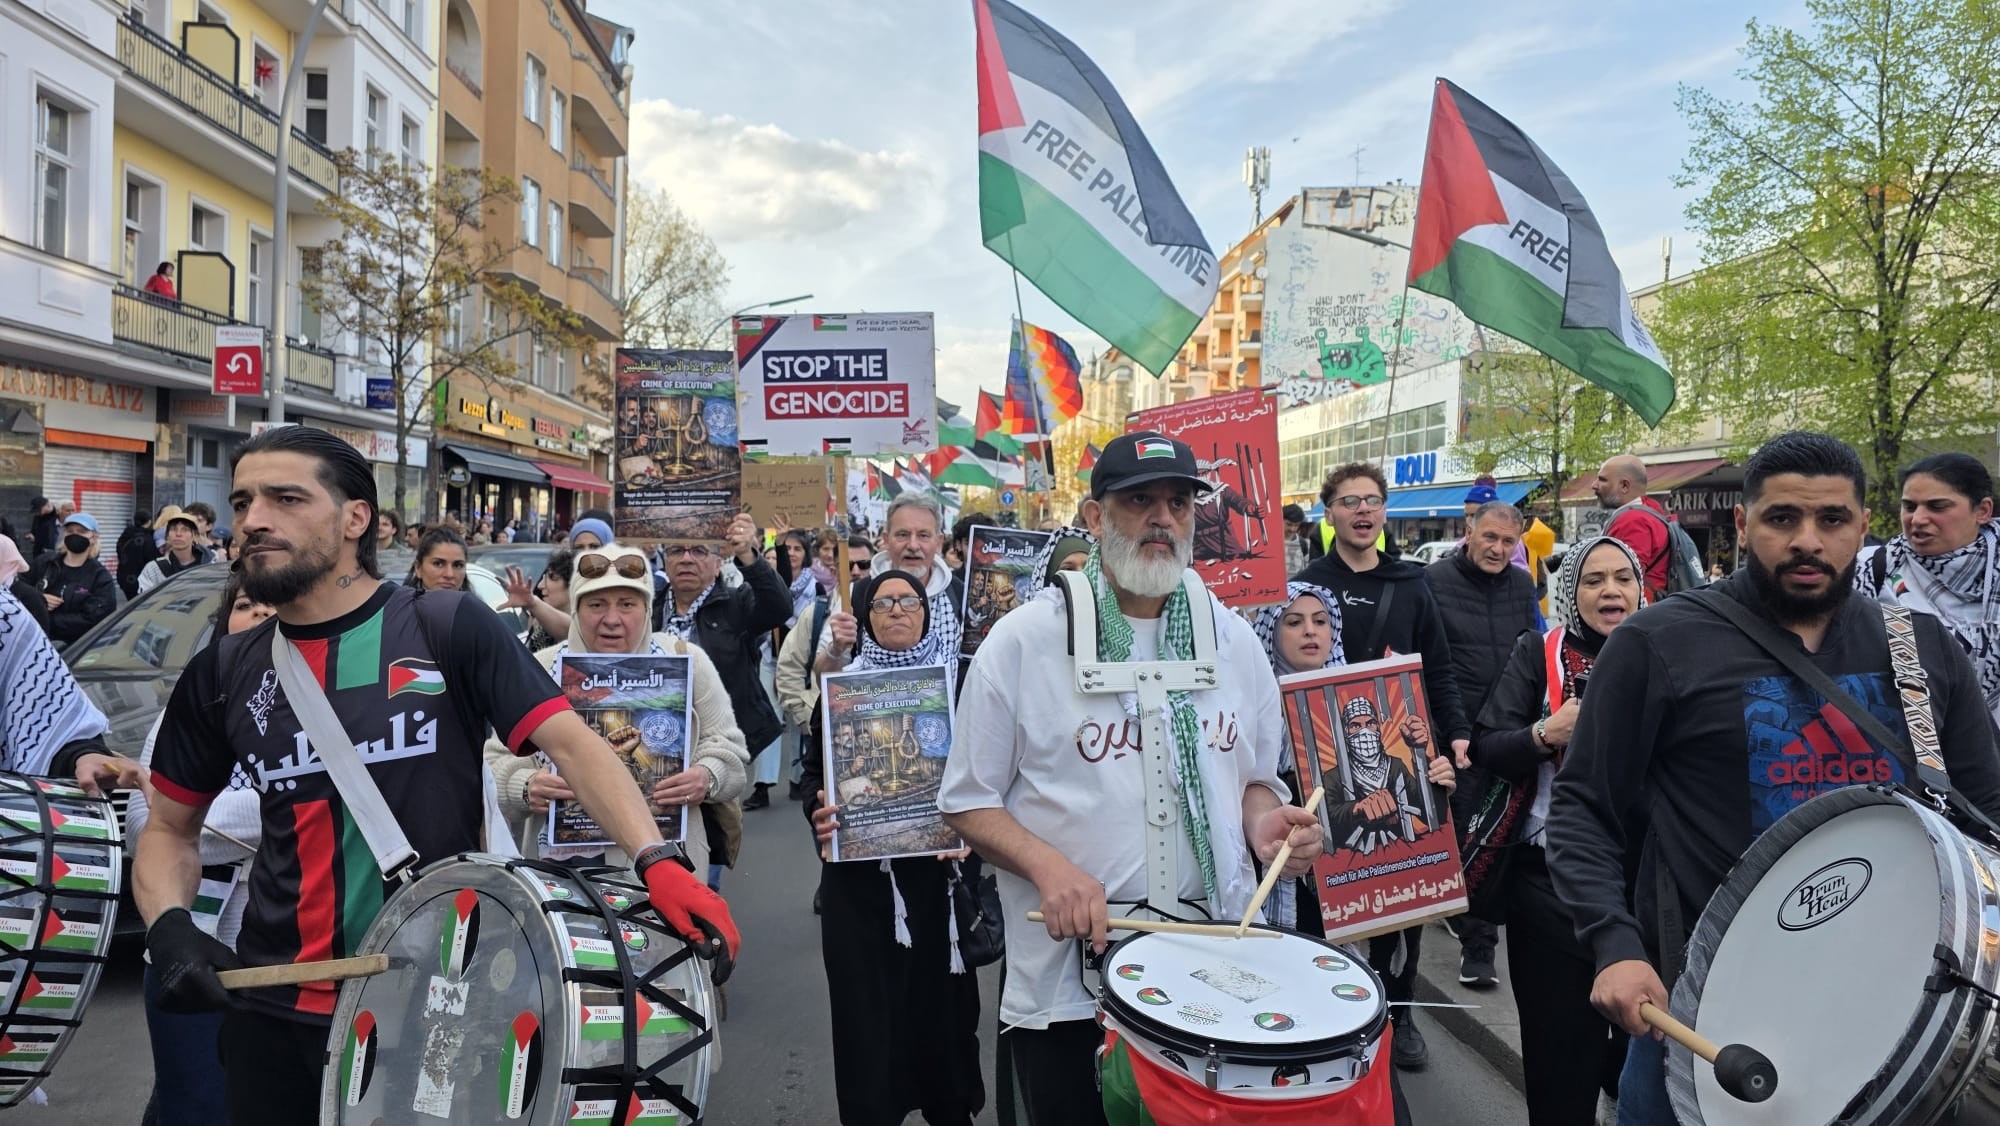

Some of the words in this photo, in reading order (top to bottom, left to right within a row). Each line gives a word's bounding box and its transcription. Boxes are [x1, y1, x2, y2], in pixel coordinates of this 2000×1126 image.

[1022, 119, 1096, 182] FREE
[1509, 219, 1570, 273] FREE
[1308, 304, 1370, 318] PRESIDENTS
[1315, 295, 1332, 306] WHY
[766, 355, 831, 379] STOP
[833, 355, 884, 378] THE
[641, 379, 663, 389] CRIME
[664, 380, 673, 389] OF
[675, 380, 713, 390] EXECUTION
[769, 390, 905, 415] GENOCIDE
[1230, 402, 1273, 422] الحرية
[1169, 410, 1227, 436] لمناضلي
[1395, 452, 1437, 485] BOLU
[1005, 541, 1034, 557] الأسير
[619, 669, 664, 692] الأسير
[853, 703, 874, 712] CRIME
[885, 699, 920, 709] EXECUTION
[1767, 753, 1892, 784] adidas
[1325, 872, 1348, 887] Freiheit
[1348, 871, 1357, 881] für
[1357, 868, 1370, 880] Alle
[1369, 858, 1417, 876] Palästinensische
[1416, 851, 1450, 866] Gefangenen
[1372, 882, 1416, 914] لعشاق
[1419, 871, 1464, 899] الحرية
[1798, 875, 1846, 907] Drum
[1321, 893, 1370, 922] الحرية
[1806, 883, 1851, 919] Head
[512, 1073, 521, 1116] Palestine
[582, 1109, 610, 1117] PALESTINE
